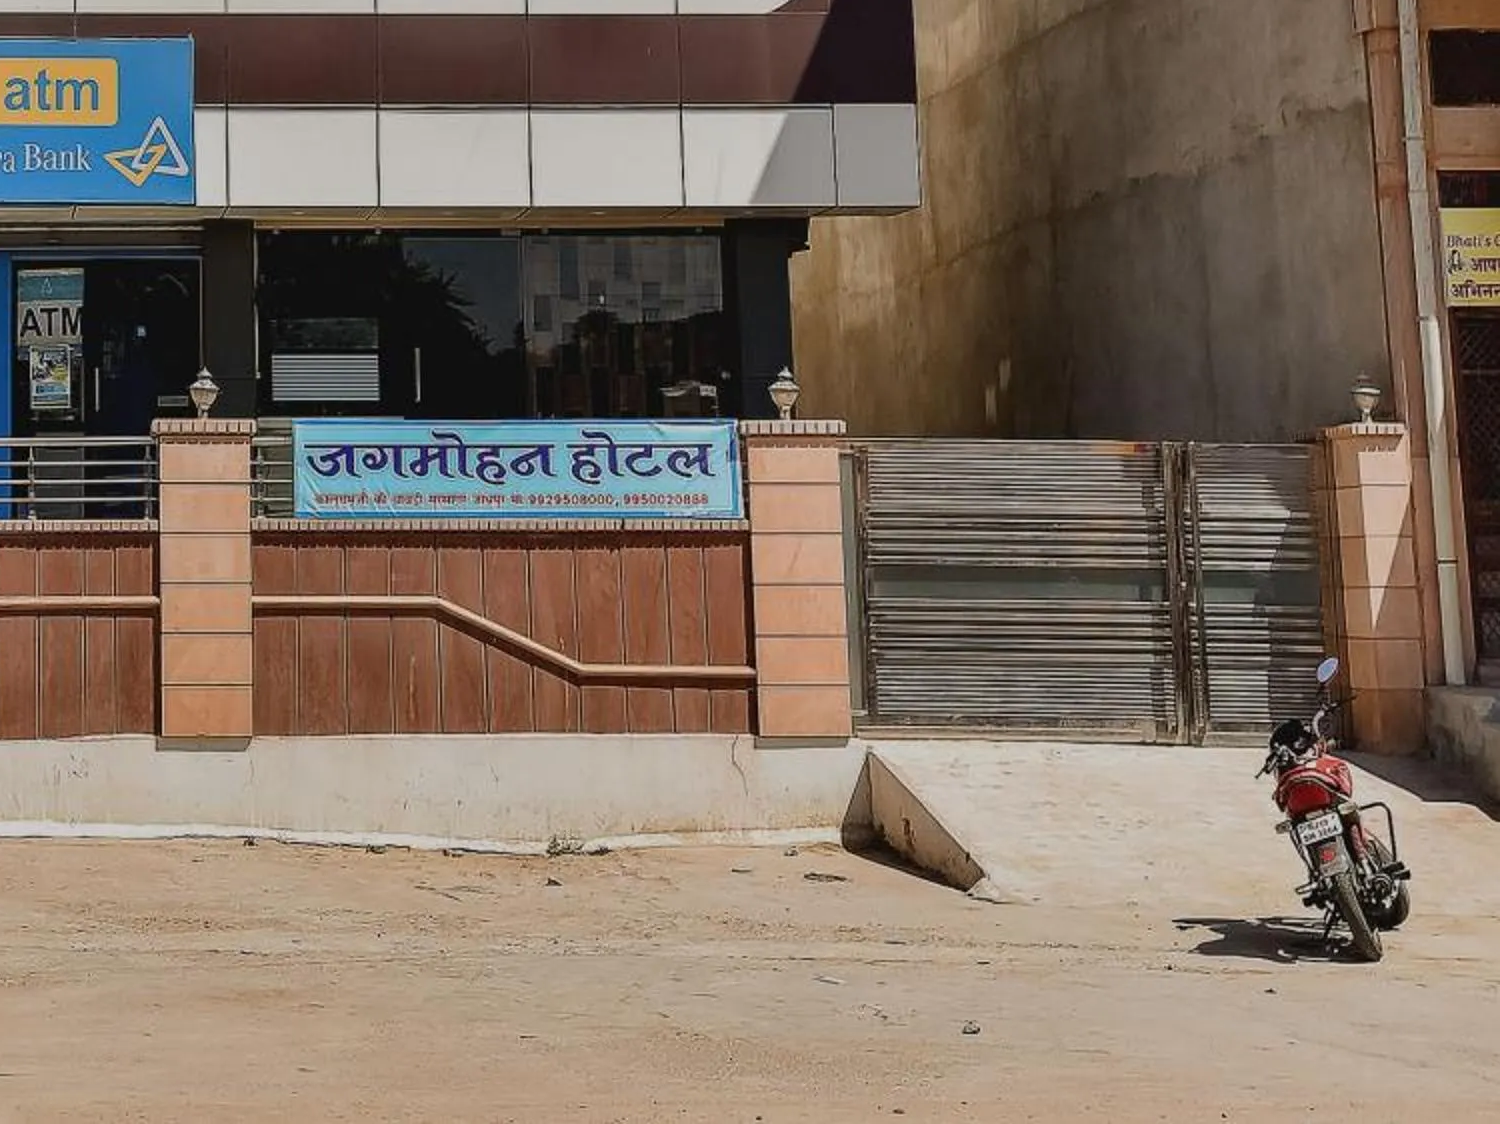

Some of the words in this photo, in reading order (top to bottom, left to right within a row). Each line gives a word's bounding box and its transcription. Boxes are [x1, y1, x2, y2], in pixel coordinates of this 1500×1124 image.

[3, 69, 99, 112] atm
[24, 143, 92, 173] Bank
[20, 307, 82, 337] ATM
[304, 430, 556, 484] जगमोहन
[566, 430, 718, 485] होटल
